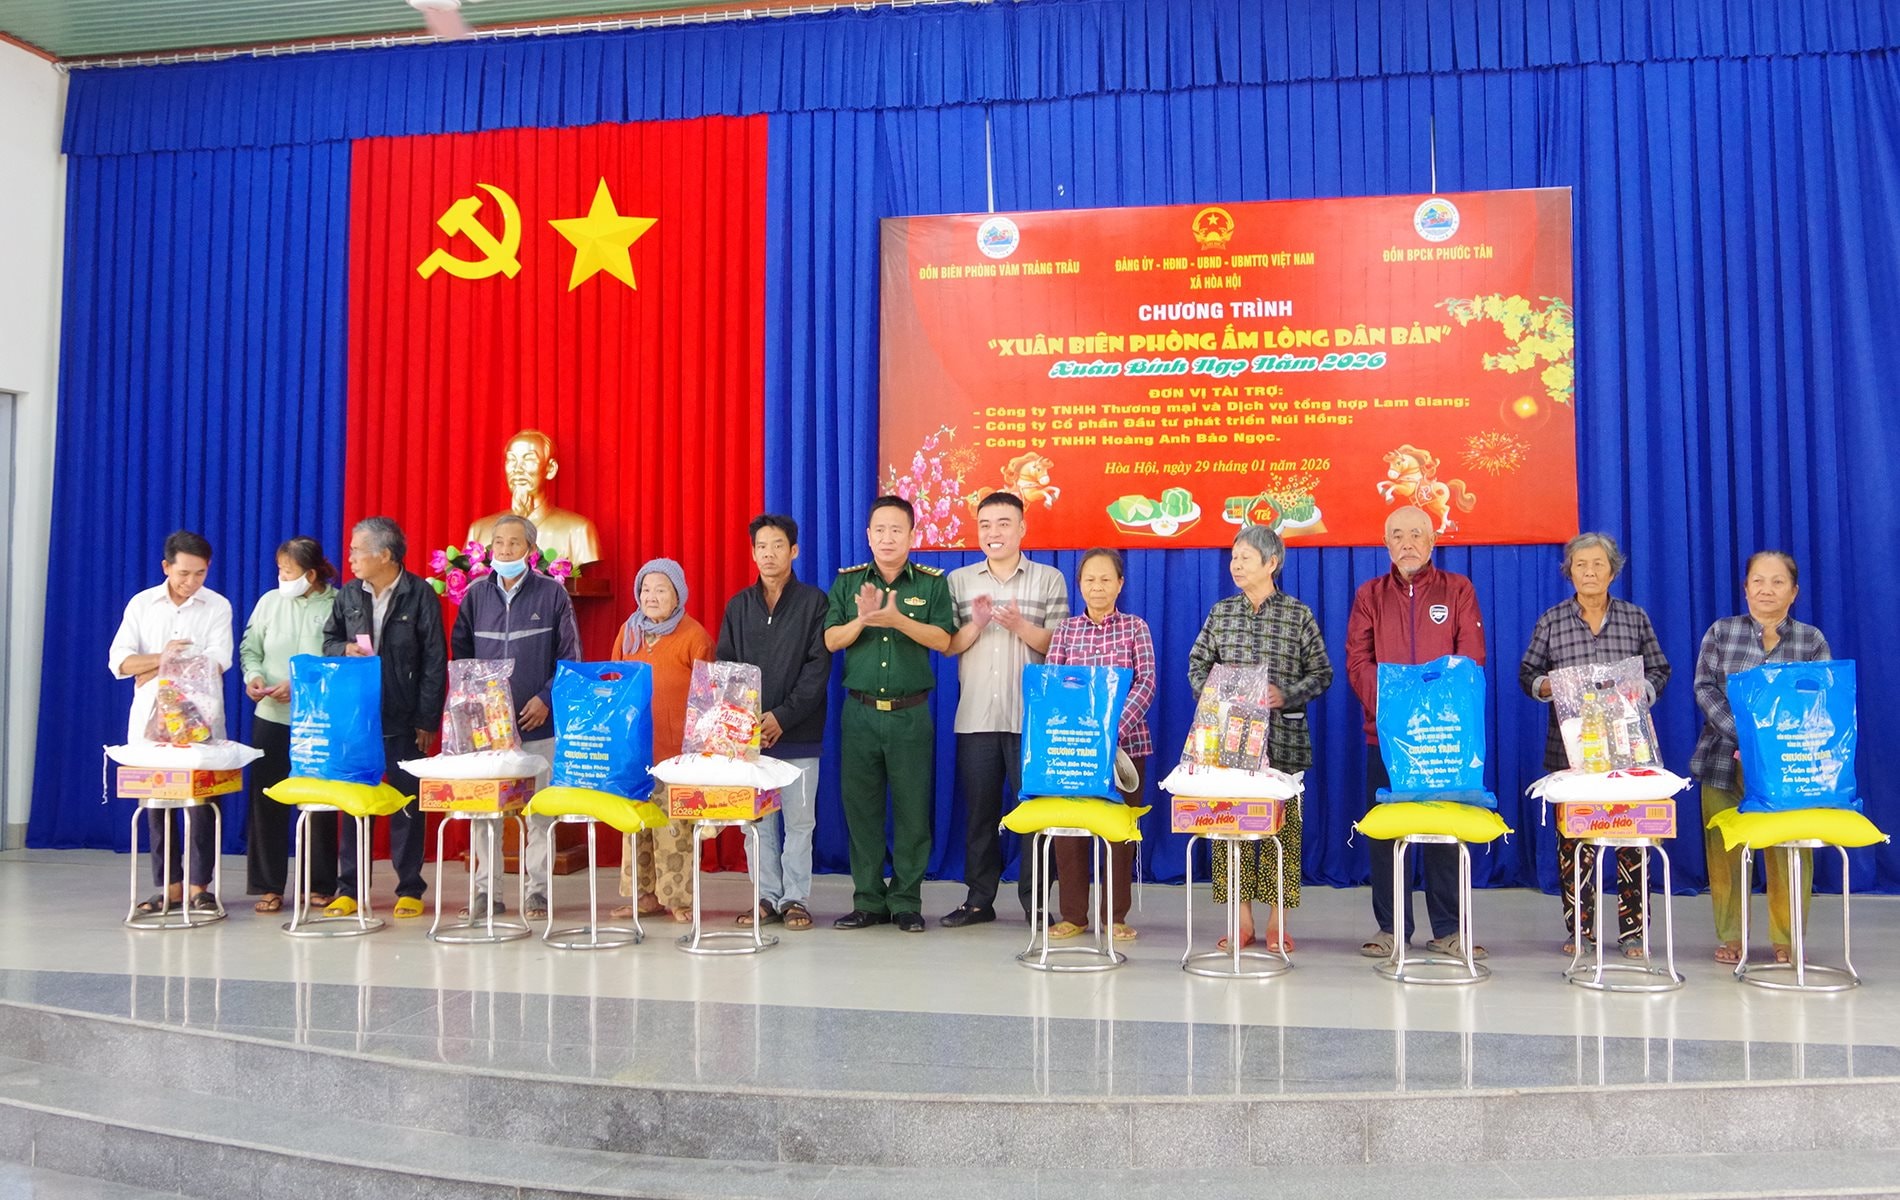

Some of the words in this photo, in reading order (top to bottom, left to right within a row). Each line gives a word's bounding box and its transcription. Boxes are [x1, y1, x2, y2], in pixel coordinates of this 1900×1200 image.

[1114, 257, 1140, 272] ĐẢNG
[1162, 257, 1189, 271] HĐND
[1196, 255, 1223, 270] UBND
[1230, 253, 1269, 268] UBMTTQ
[1270, 250, 1292, 269] VIỆT
[1293, 252, 1315, 266] NAM
[1407, 249, 1435, 261] BPCK
[1435, 246, 1472, 260] PHƯỚC
[1473, 245, 1494, 259] TÂN
[940, 263, 963, 279] BIÊN
[964, 262, 997, 278] PHÒNG
[998, 262, 1020, 277] VÀM
[1054, 258, 1081, 274] TRÂU
[1189, 274, 1203, 290] XÃ
[1203, 273, 1224, 289] HÒA
[1224, 272, 1242, 290] HỘI
[1138, 301, 1224, 322] CHƯƠNG
[1229, 297, 1293, 319] TRÌNH
[1068, 331, 1125, 355] BIÊN
[1128, 329, 1218, 353] PHÒNG
[1220, 323, 1259, 350] ẤM
[1263, 325, 1330, 349] LÒNG
[1334, 323, 1386, 347] DÂN
[1050, 361, 1121, 377] Xuân
[1193, 357, 1248, 376] Ngọ
[1253, 354, 1318, 371] Năm
[1320, 353, 1386, 370] 2026
[1148, 387, 1185, 399] ĐƠN
[1189, 387, 1207, 399] VỊ
[1211, 385, 1239, 397] TÀI
[985, 407, 1027, 418] Công
[1030, 406, 1047, 418] ty
[1050, 404, 1097, 416] TNHH
[1100, 404, 1162, 415] Thương
[1166, 402, 1197, 414] mại
[1201, 401, 1222, 412] và
[1226, 400, 1264, 413] Dịch
[1268, 402, 1289, 412] vụ
[1336, 399, 1369, 410] hợp
[1373, 398, 1409, 408] Lam
[1414, 396, 1470, 408] Giang;
[985, 421, 1027, 432] Công
[1030, 420, 1047, 432] ty
[1160, 417, 1179, 427] tư
[1183, 416, 1222, 429] phát
[1270, 414, 1299, 425] Núi
[985, 437, 1027, 449] Công
[1030, 437, 1047, 449] ty
[1051, 435, 1097, 446] TNHH
[1101, 435, 1155, 446] Hoàng
[1158, 433, 1191, 444] Anh
[1195, 432, 1229, 443] Bảo
[1233, 432, 1281, 444] Ngọc.
[1104, 461, 1131, 474] Hòa
[1133, 461, 1160, 476] Hội,
[1162, 460, 1193, 476] ngày
[1194, 460, 1211, 473] 29
[1212, 459, 1249, 475] tháng
[1250, 459, 1266, 472] 01
[1269, 459, 1297, 471] năm
[1299, 457, 1331, 471] 2026
[1195, 813, 1215, 826] Hảo
[1216, 811, 1236, 824] Hảo
[1590, 817, 1610, 831] Hảo
[1612, 814, 1633, 828] Hảo
